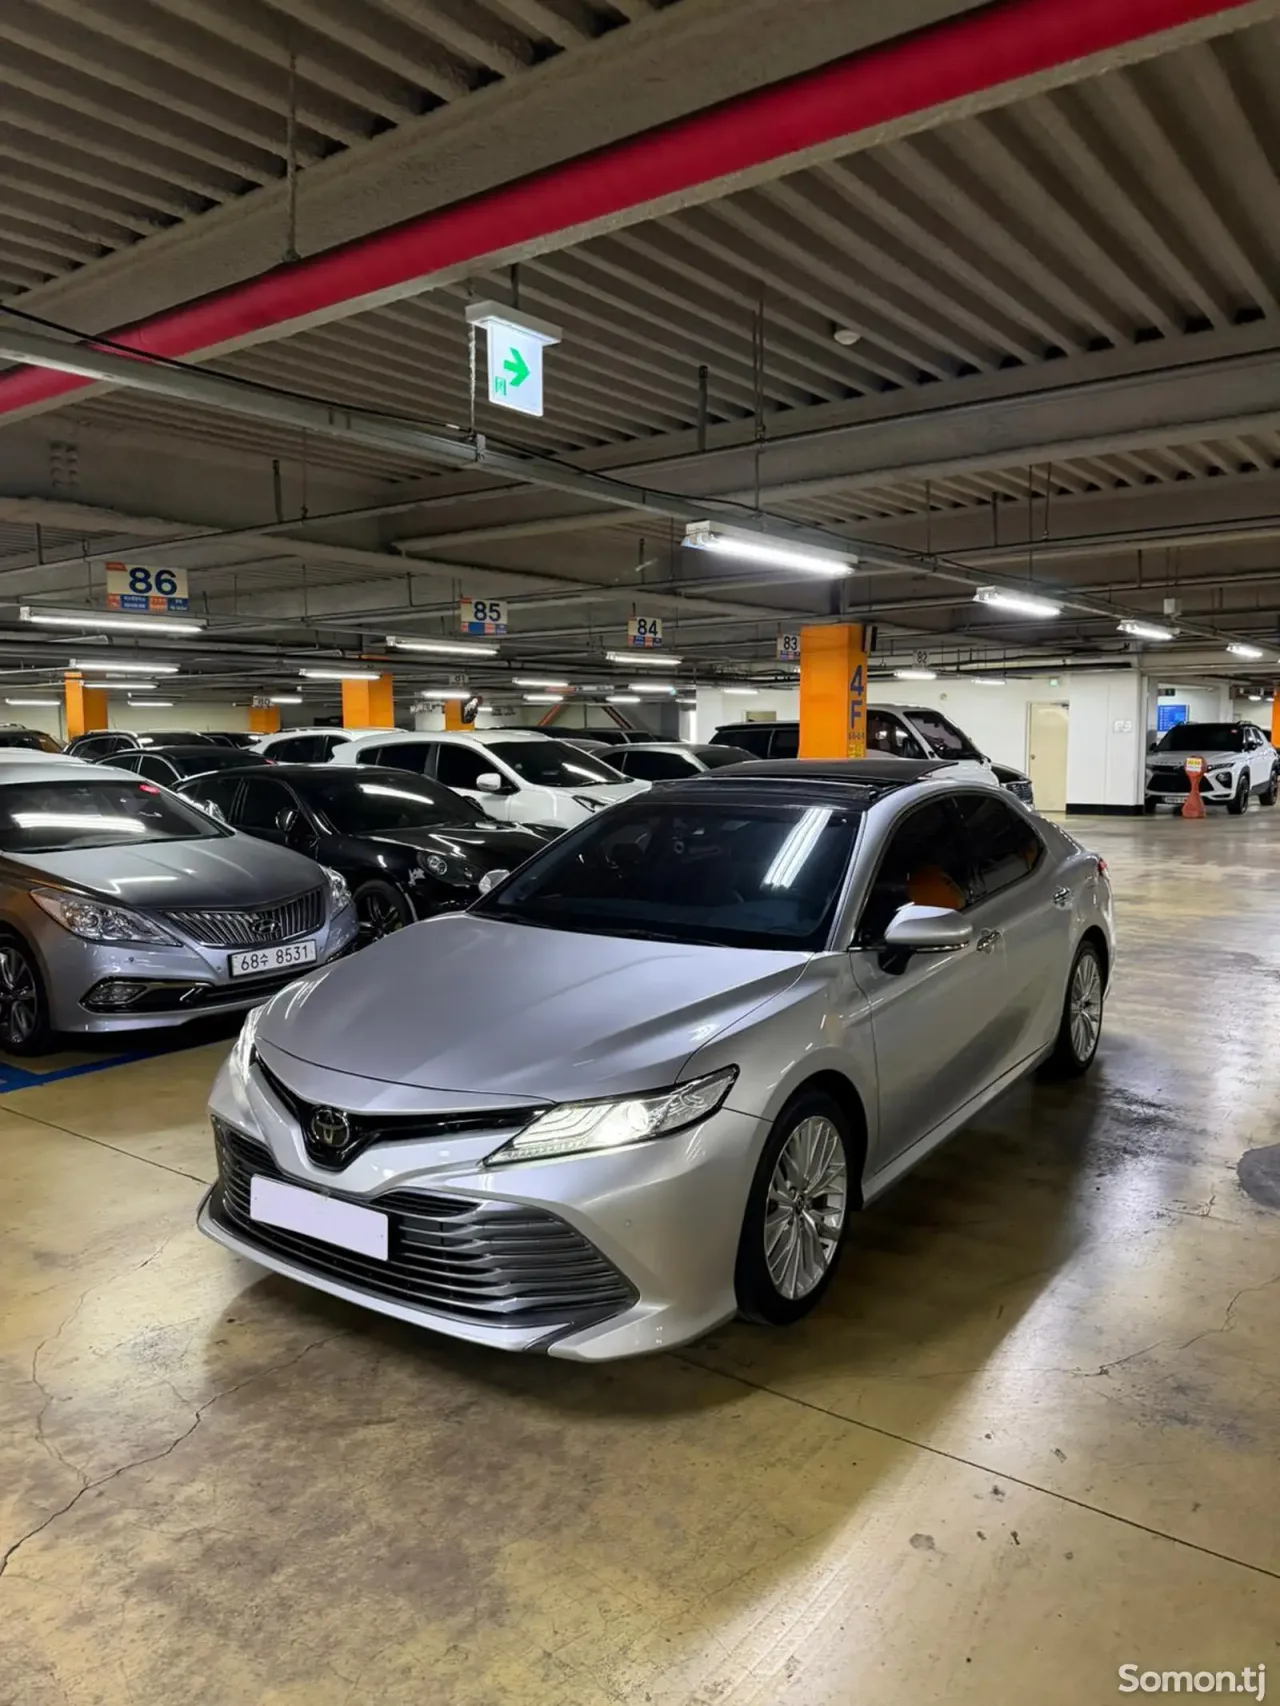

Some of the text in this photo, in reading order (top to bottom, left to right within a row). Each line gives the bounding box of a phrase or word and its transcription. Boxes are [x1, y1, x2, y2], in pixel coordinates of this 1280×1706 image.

[129, 567, 177, 595] 86
[474, 600, 501, 621] 85
[637, 618, 658, 636] 84
[783, 635, 797, 650] 83
[917, 651, 928, 663] 82
[241, 945, 308, 971] 68수 8531
